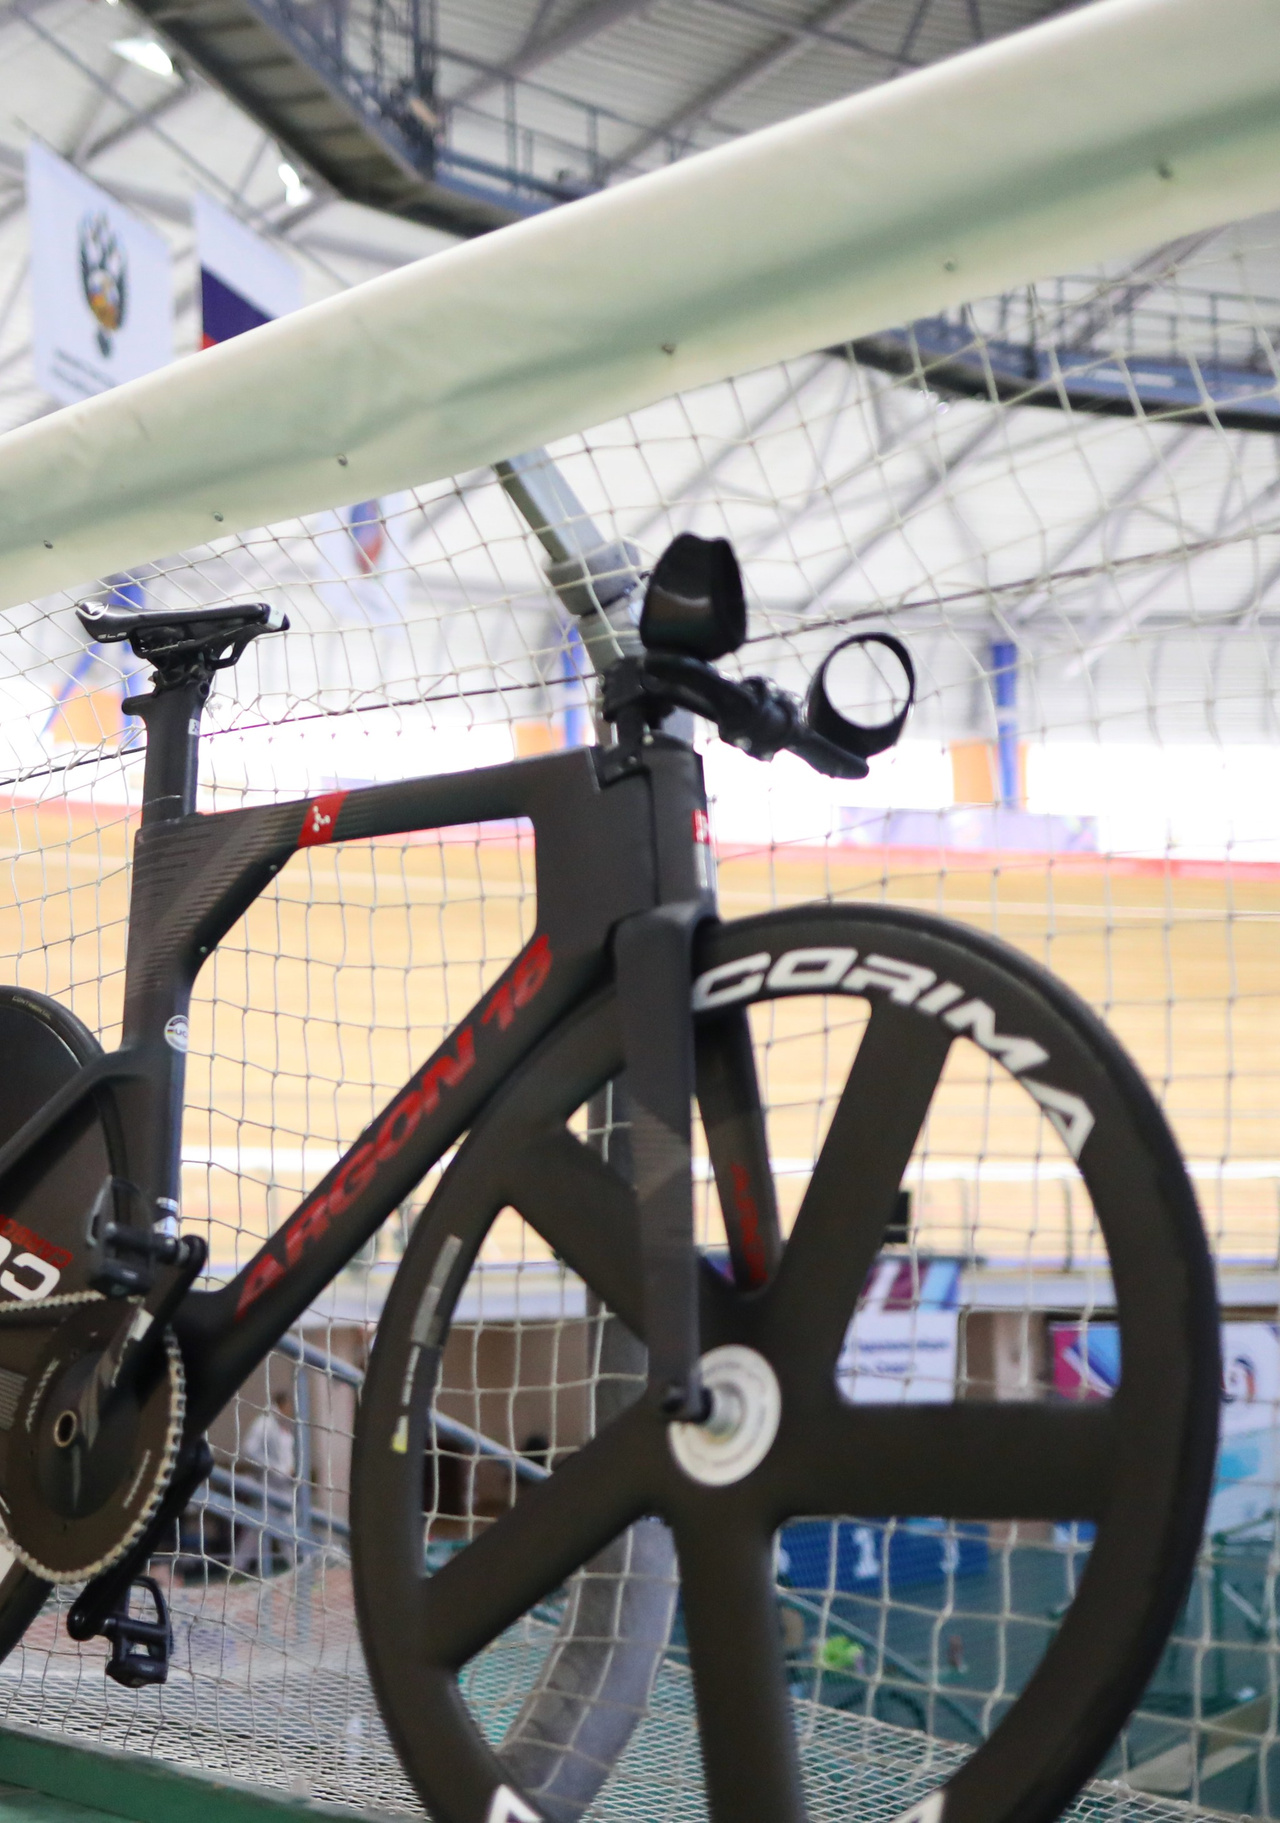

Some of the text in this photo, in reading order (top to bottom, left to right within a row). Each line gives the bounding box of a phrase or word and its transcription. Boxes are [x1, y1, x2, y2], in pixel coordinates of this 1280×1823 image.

[235, 933, 554, 1322] ARGON 18
[693, 946, 1095, 1161] CORIMA
